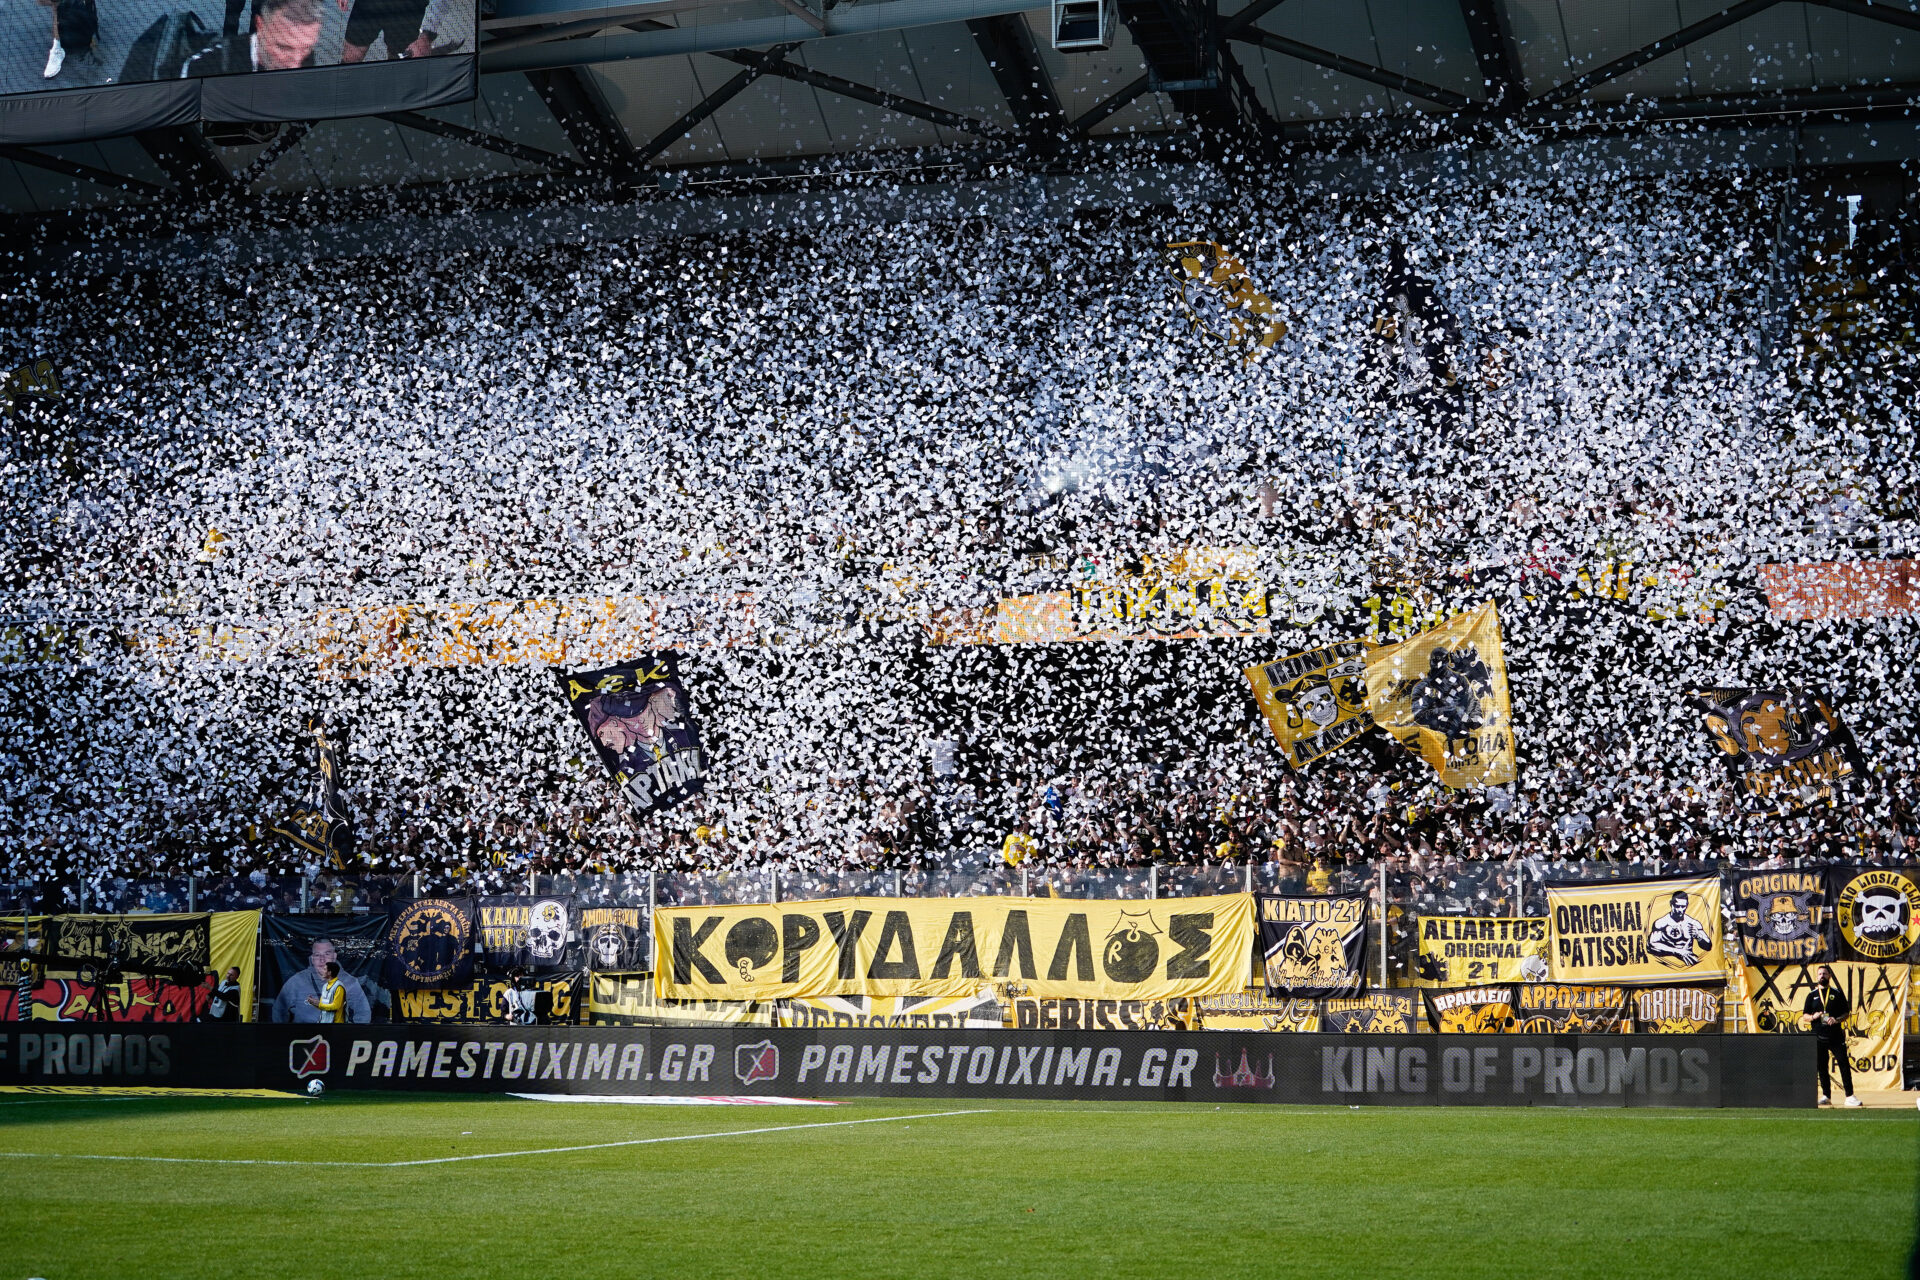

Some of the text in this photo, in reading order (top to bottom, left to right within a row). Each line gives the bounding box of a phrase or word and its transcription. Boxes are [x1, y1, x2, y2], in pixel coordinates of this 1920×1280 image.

[1740, 873, 1825, 898] ORIGINAL
[1840, 872, 1920, 911] ANO LIOSIA CLUB
[481, 906, 531, 926] KAMA
[1263, 899, 1331, 922] KIATO
[1556, 901, 1643, 935] ORIGINAL
[1746, 909, 1759, 927] 9
[1424, 918, 1545, 942] ALIARTOS
[57, 929, 198, 958] SALNICA
[672, 909, 1215, 985] ΚΟΡΥΔΑΛΛΟΣ
[1444, 942, 1525, 959] ORIGINAL
[1559, 935, 1649, 968] PATISSIA
[1743, 935, 1829, 959] KARDITSA
[1853, 935, 1912, 957] ORIGINAL 21
[1468, 961, 1499, 980] 21
[399, 982, 481, 1018] WEST
[1328, 994, 1412, 1015] ORIGINAL 21
[1434, 989, 1512, 1012] ΗΡΑΚΛΕΙΟ
[1519, 985, 1625, 1009] ΑΡΡΩΣΤΕΙΑ
[19, 1033, 172, 1076] PROMOS
[346, 1040, 716, 1082] PAMESTOIXIMA.GR
[797, 1044, 1199, 1088] PAMESTOIXIMA.GR
[1321, 1046, 1710, 1095] KING OF PROMOS
